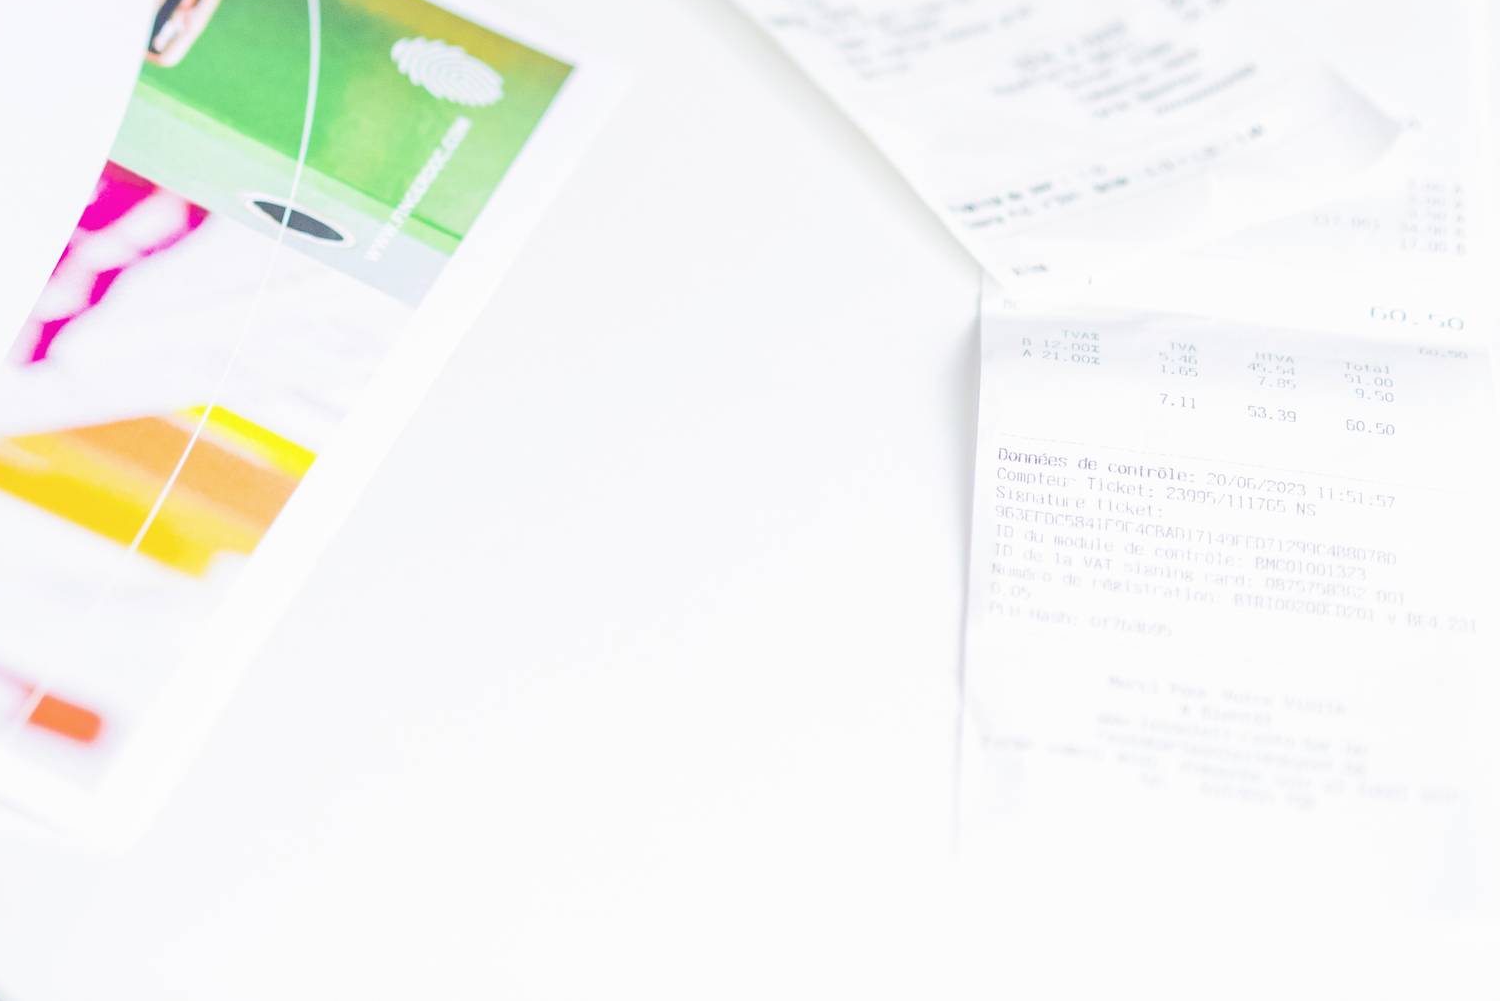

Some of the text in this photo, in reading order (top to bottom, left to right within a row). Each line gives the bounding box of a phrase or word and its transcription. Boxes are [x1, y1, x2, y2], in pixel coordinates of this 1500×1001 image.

[1368, 305, 1466, 332] 60.50
[1168, 341, 1198, 353] TVA
[1159, 363, 1199, 379] 1.65
[1257, 375, 1298, 391] 7.85
[1354, 388, 1396, 403] 9.50
[1343, 361, 1392, 375] Total
[1343, 373, 1395, 389] 51.00
[1158, 392, 1397, 437] 7.11 53.39 60.50
[996, 466, 1077, 487] Compteur
[1086, 475, 1155, 499] Ticket:
[1295, 500, 1318, 518] NS
[997, 447, 1397, 510] Données de contrôle: 20/06/2023 11:51:57
[995, 485, 1164, 519] Signature ticket:
[995, 524, 1014, 539] ID
[1024, 528, 1045, 544] du
[1052, 533, 1115, 554] module
[1123, 542, 1145, 557] de
[995, 542, 1013, 558] ID
[1083, 555, 1114, 571] VAT
